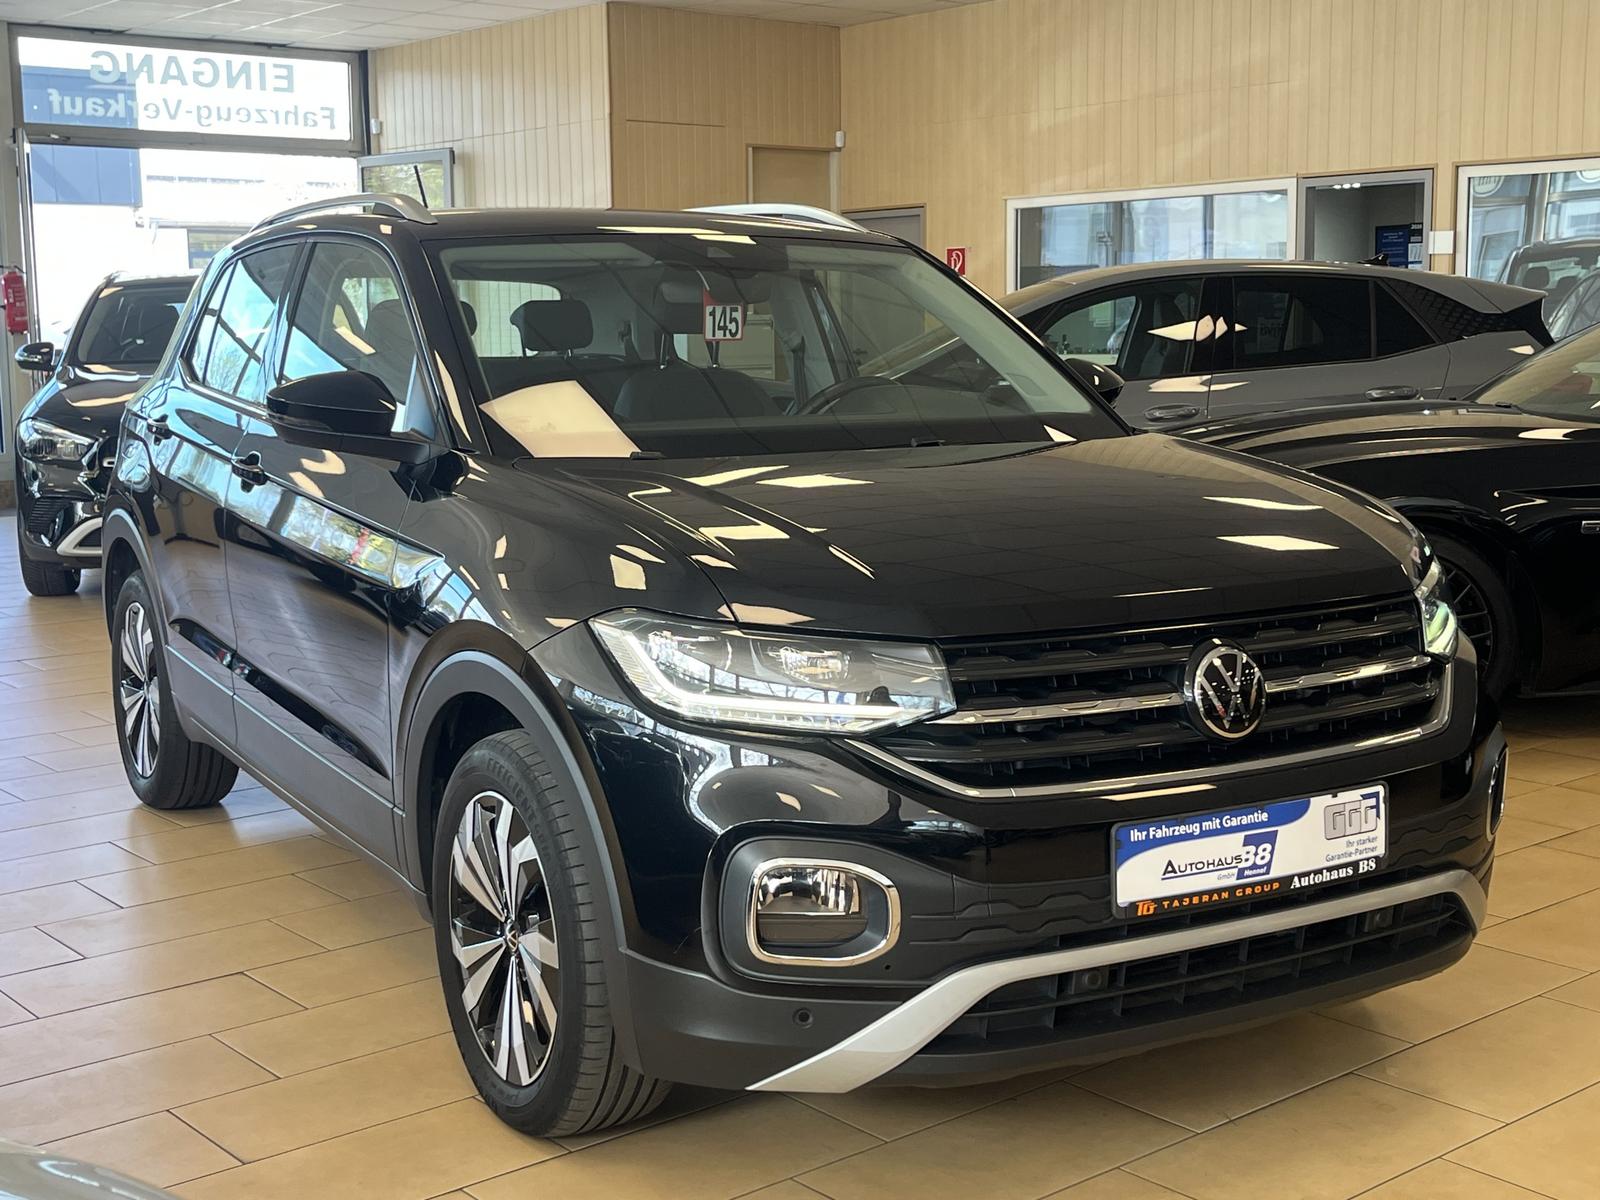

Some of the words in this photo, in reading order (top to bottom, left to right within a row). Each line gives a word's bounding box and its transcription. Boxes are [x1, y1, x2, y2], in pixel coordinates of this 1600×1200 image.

[709, 306, 739, 338] 145
[1130, 829, 1148, 842] Ihr
[1149, 823, 1200, 840] Fahrzeug
[1202, 817, 1221, 831] mit
[1223, 811, 1269, 828] Garantie
[1235, 882, 1281, 897] GROUP
[1290, 866, 1354, 889] Autohaus
[1358, 858, 1377, 874] B8
